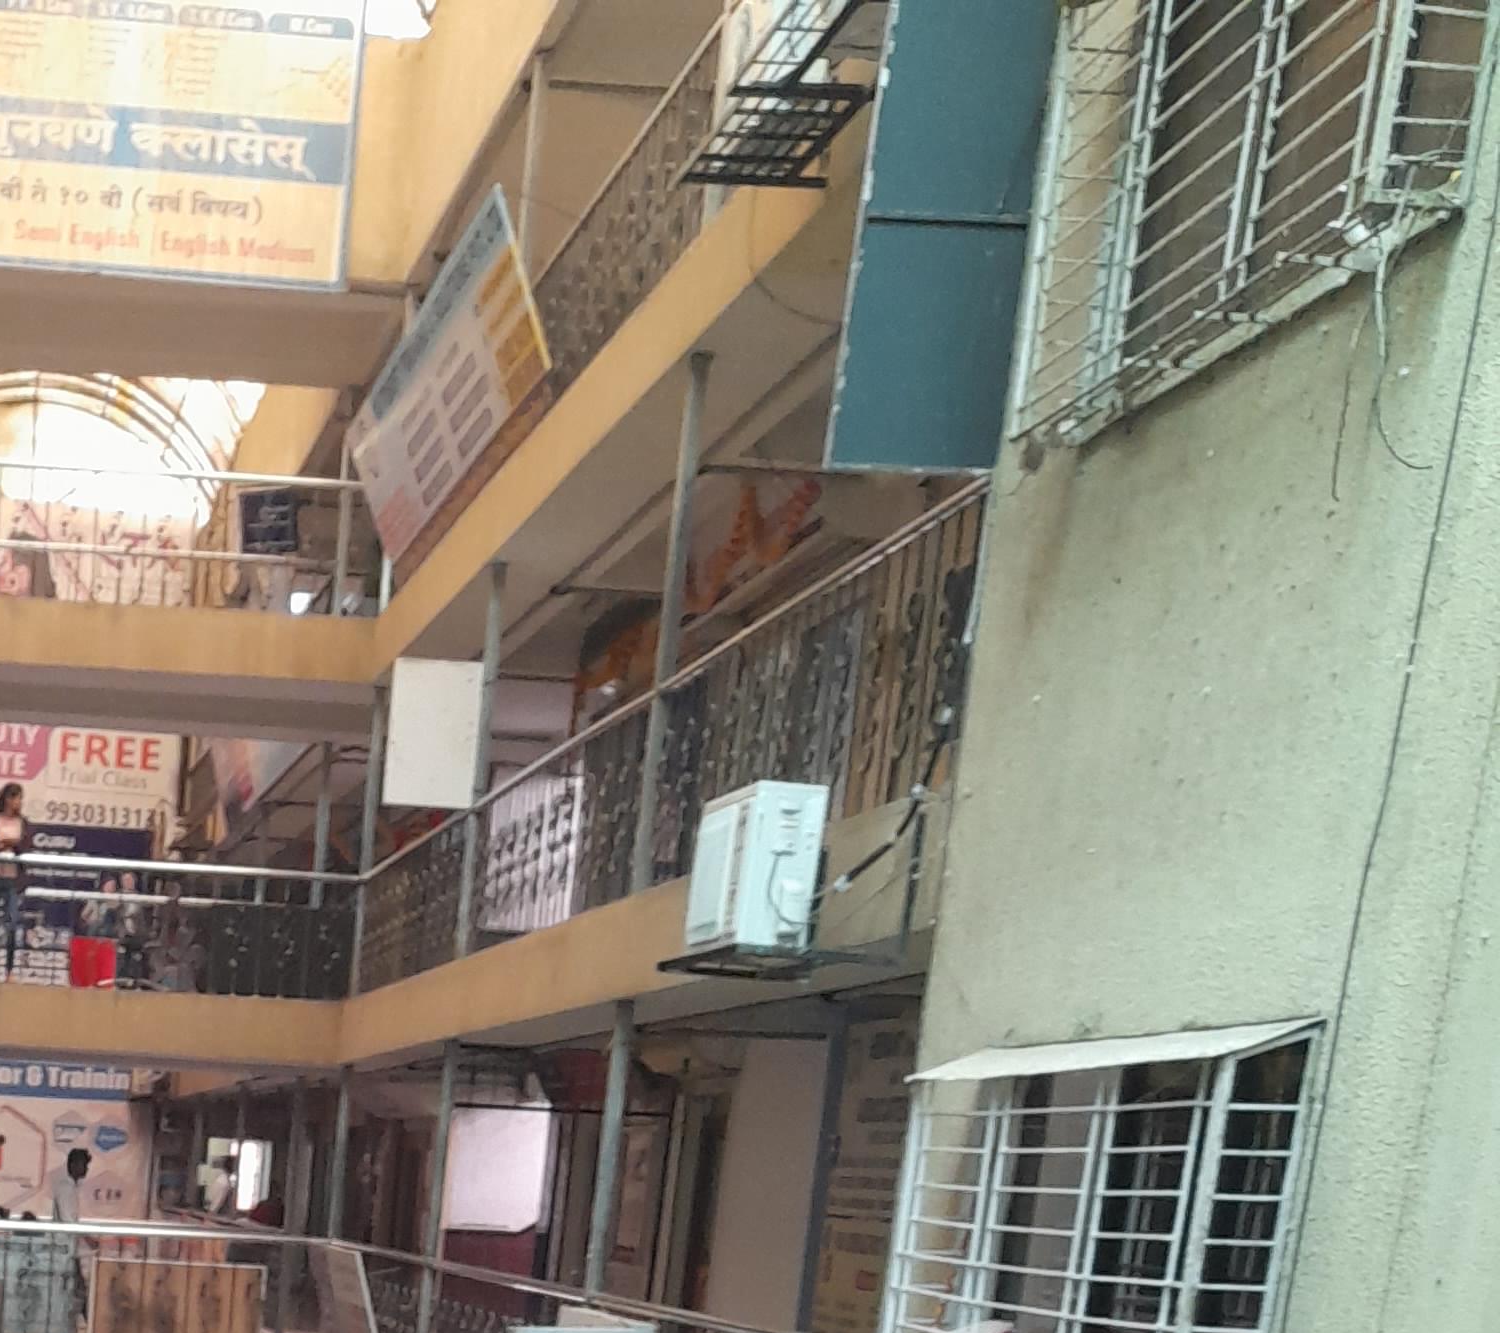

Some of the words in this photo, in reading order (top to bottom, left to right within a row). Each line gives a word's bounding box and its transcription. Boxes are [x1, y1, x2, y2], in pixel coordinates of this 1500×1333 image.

[58, 731, 161, 771] FREE
[59, 765, 98, 787] Trial
[102, 769, 147, 790] Class
[48, 1066, 132, 1092] Trainin
